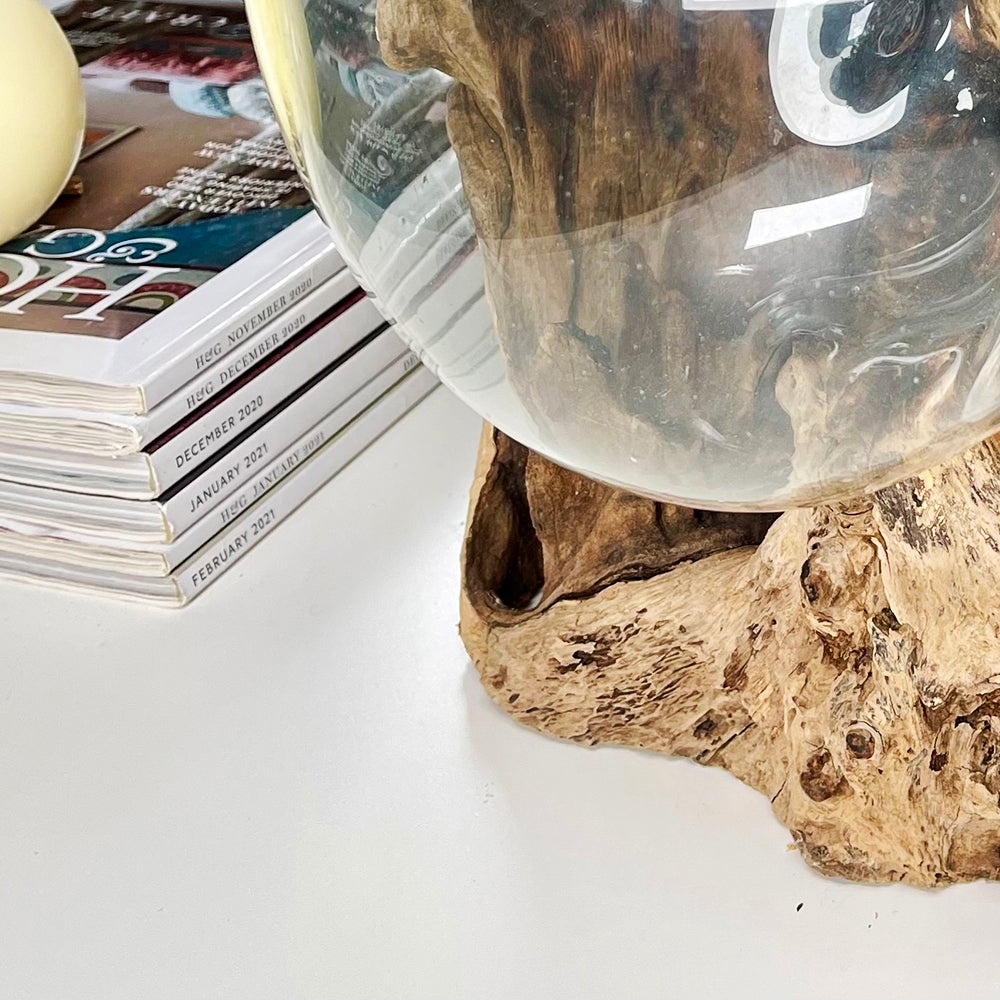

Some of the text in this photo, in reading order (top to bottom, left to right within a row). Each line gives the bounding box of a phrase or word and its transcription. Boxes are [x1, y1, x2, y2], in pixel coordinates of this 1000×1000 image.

[186, 314, 306, 409] H&G DECEMBER 2020
[194, 278, 312, 369] H&G NOVEMBER 2020
[175, 395, 264, 468] DECEMBER 2020
[190, 443, 268, 512] JANUARY 2021
[220, 431, 325, 523] H&G JANUARY 2021
[191, 508, 277, 587] FEBRUARY 2021
